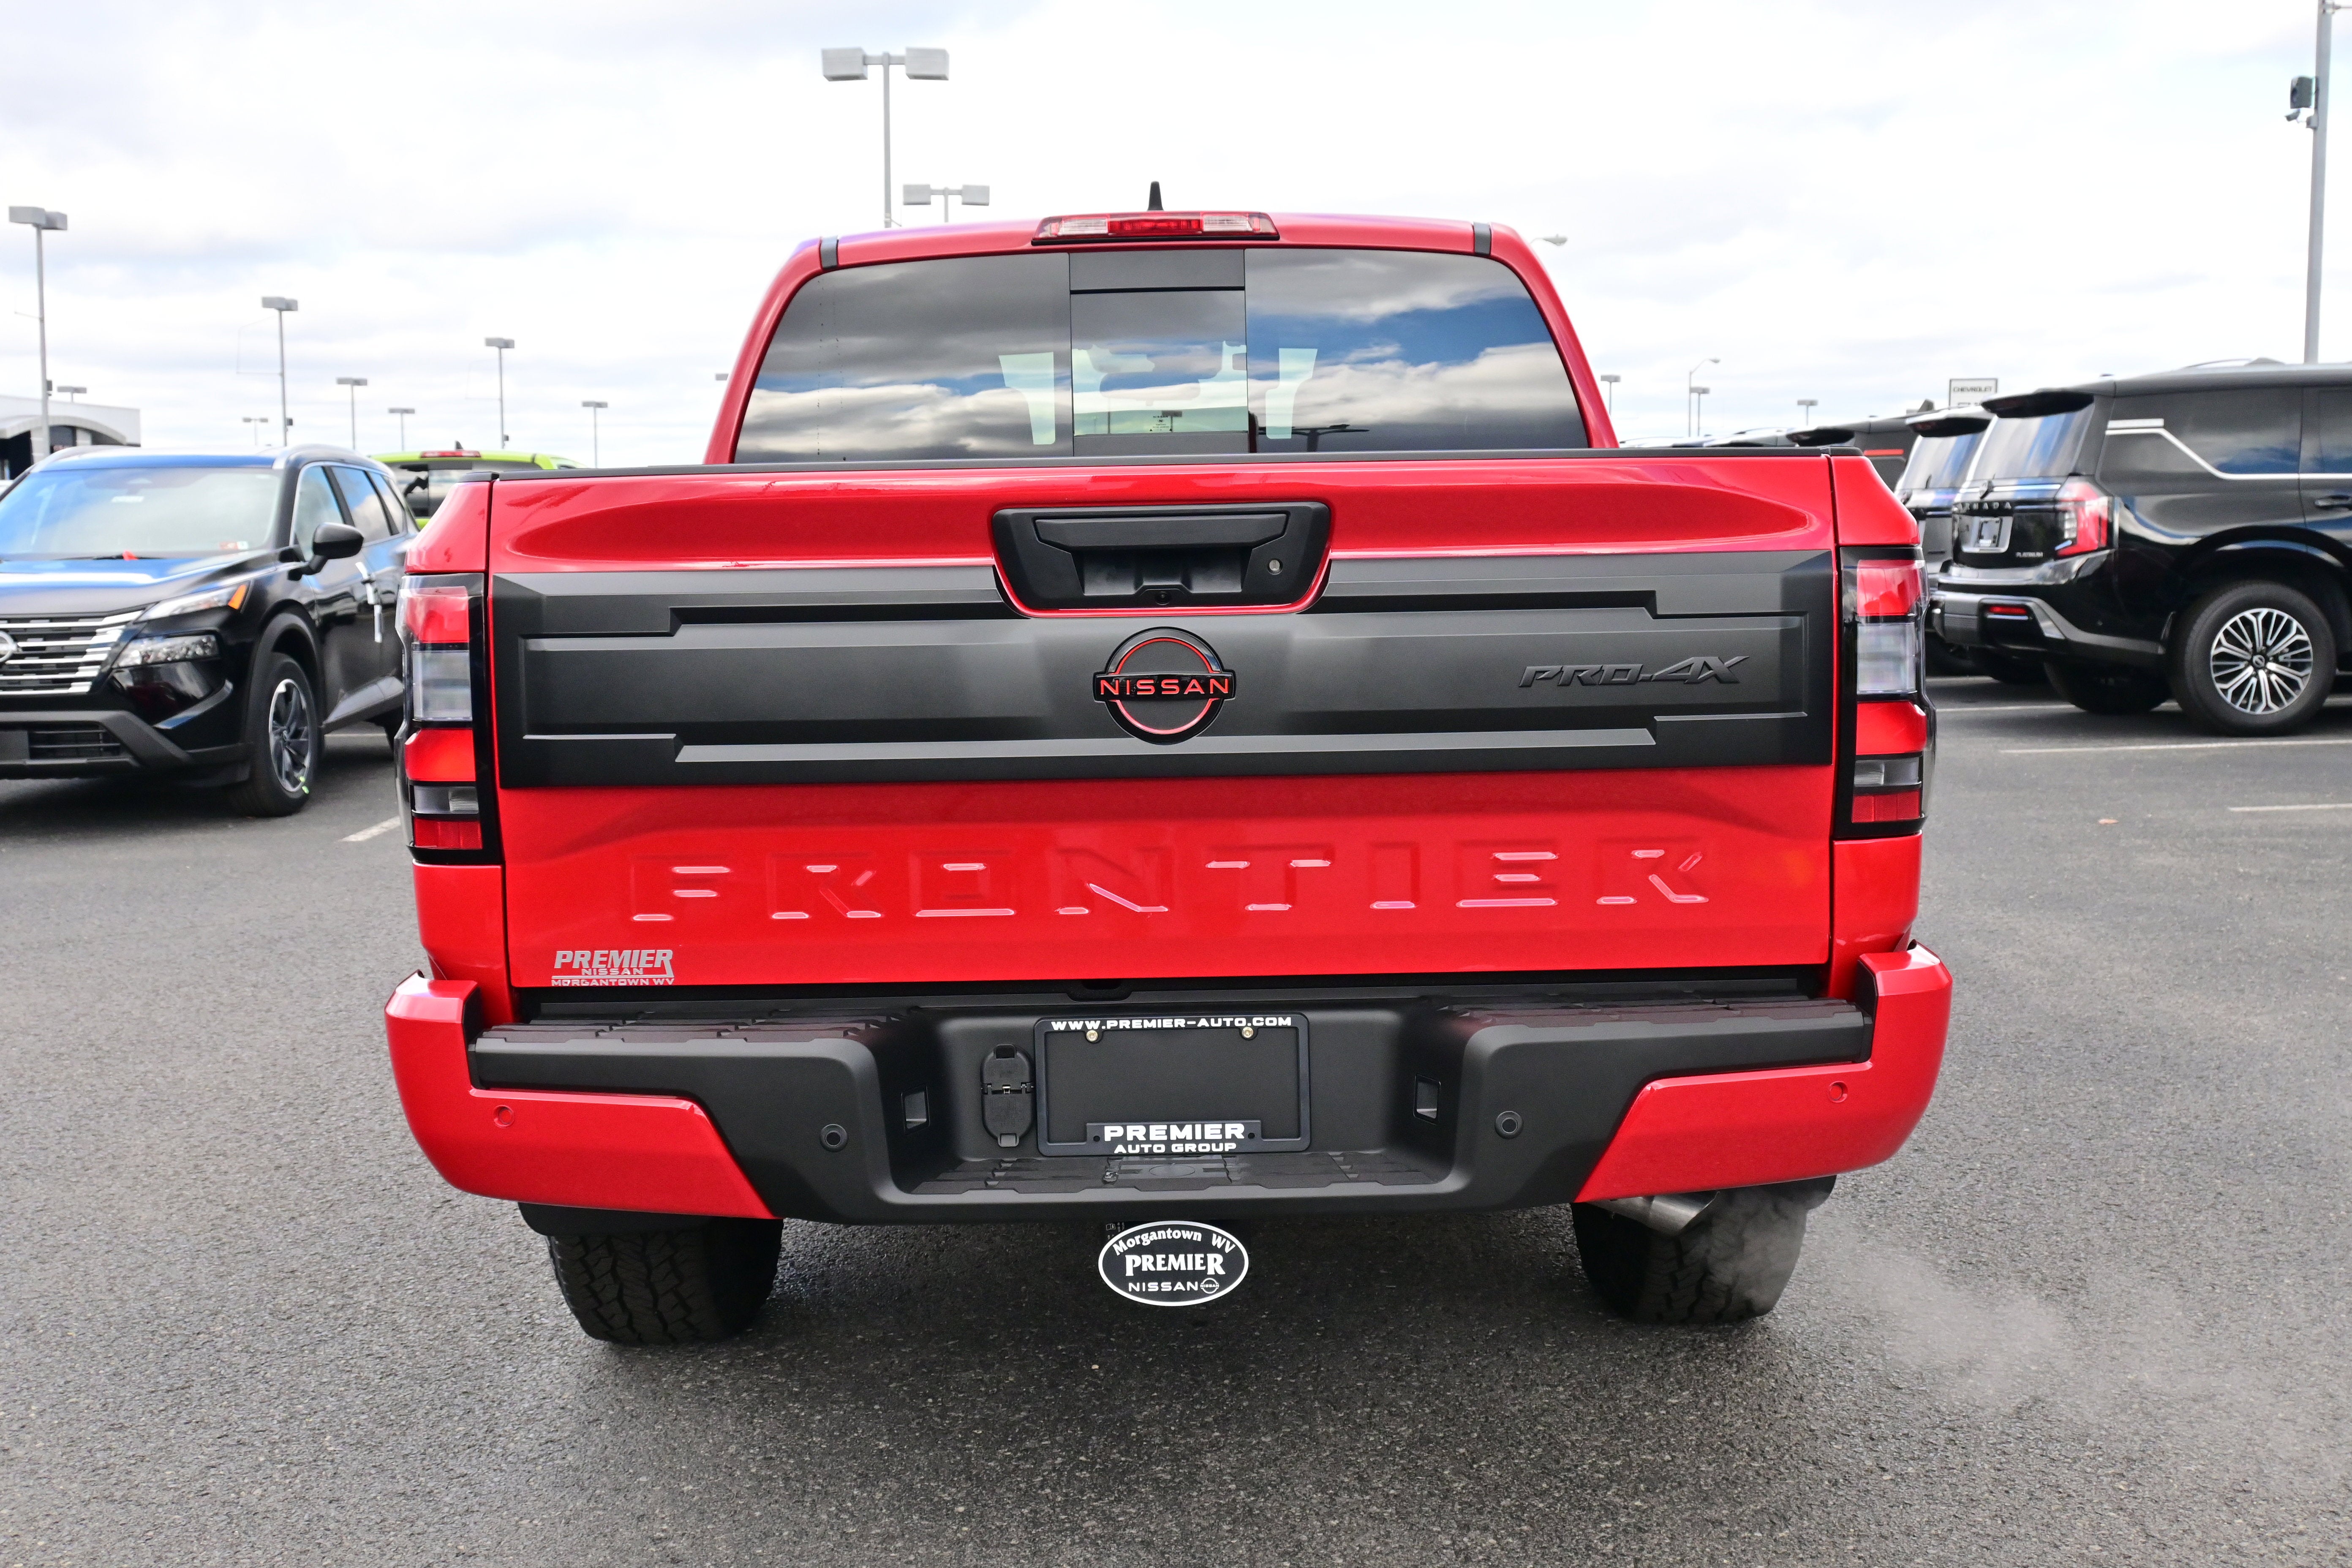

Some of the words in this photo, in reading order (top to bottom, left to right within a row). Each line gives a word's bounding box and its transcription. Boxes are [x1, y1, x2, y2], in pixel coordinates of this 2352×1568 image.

[1519, 656, 1749, 688] PRO-4X
[1100, 678, 1228, 695] NISSAN
[629, 837, 1711, 923] FRONTIER
[554, 950, 674, 971] PREMIER
[1051, 1017, 1291, 1030] WWW.PREMIER-AUTO.COM
[1104, 1123, 1244, 1141] PREMIER
[1114, 1144, 1165, 1154] AUTO
[1171, 1143, 1236, 1152] GROUP
[1113, 1228, 1202, 1256] Morgantown
[1211, 1233, 1236, 1253] WV
[1125, 1253, 1225, 1277] PREMIER
[1129, 1282, 1198, 1292] NISSAN
